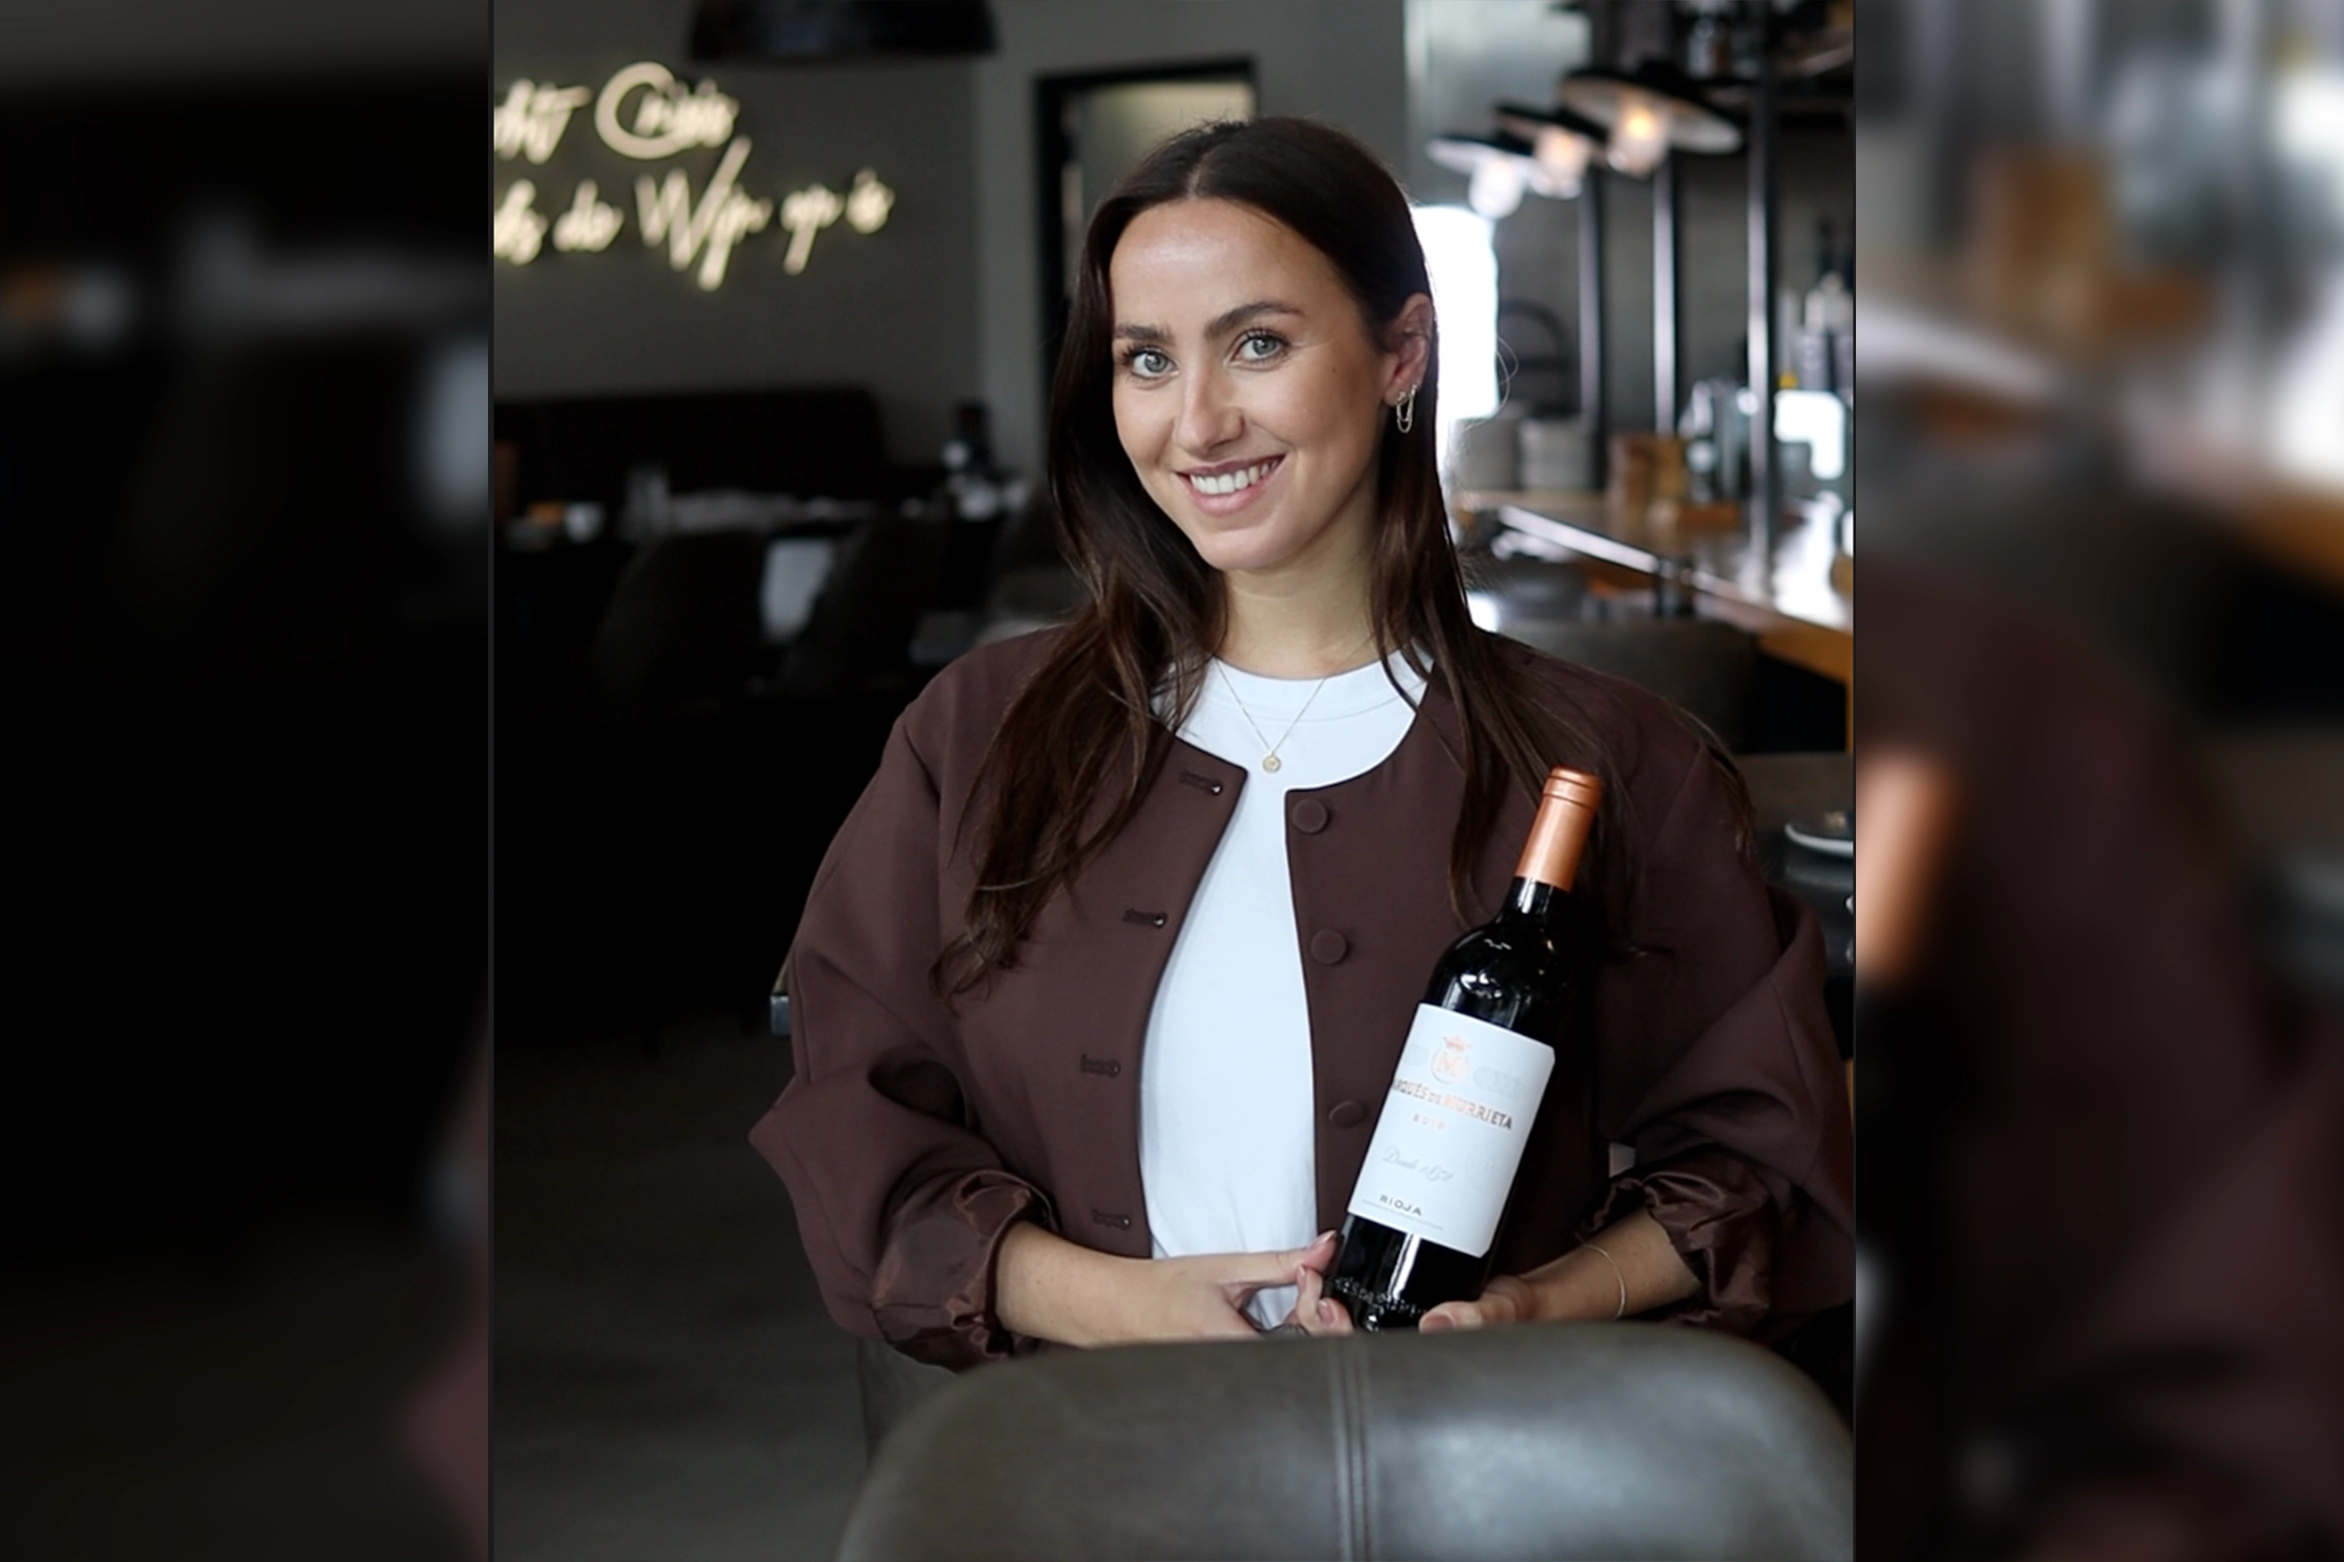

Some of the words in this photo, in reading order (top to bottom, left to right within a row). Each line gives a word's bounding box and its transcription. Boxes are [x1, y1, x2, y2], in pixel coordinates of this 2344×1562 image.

[1436, 1050, 1460, 1080] M
[1442, 1092, 1513, 1131] MURRIETA
[1379, 1193, 1422, 1216] RIOJA
